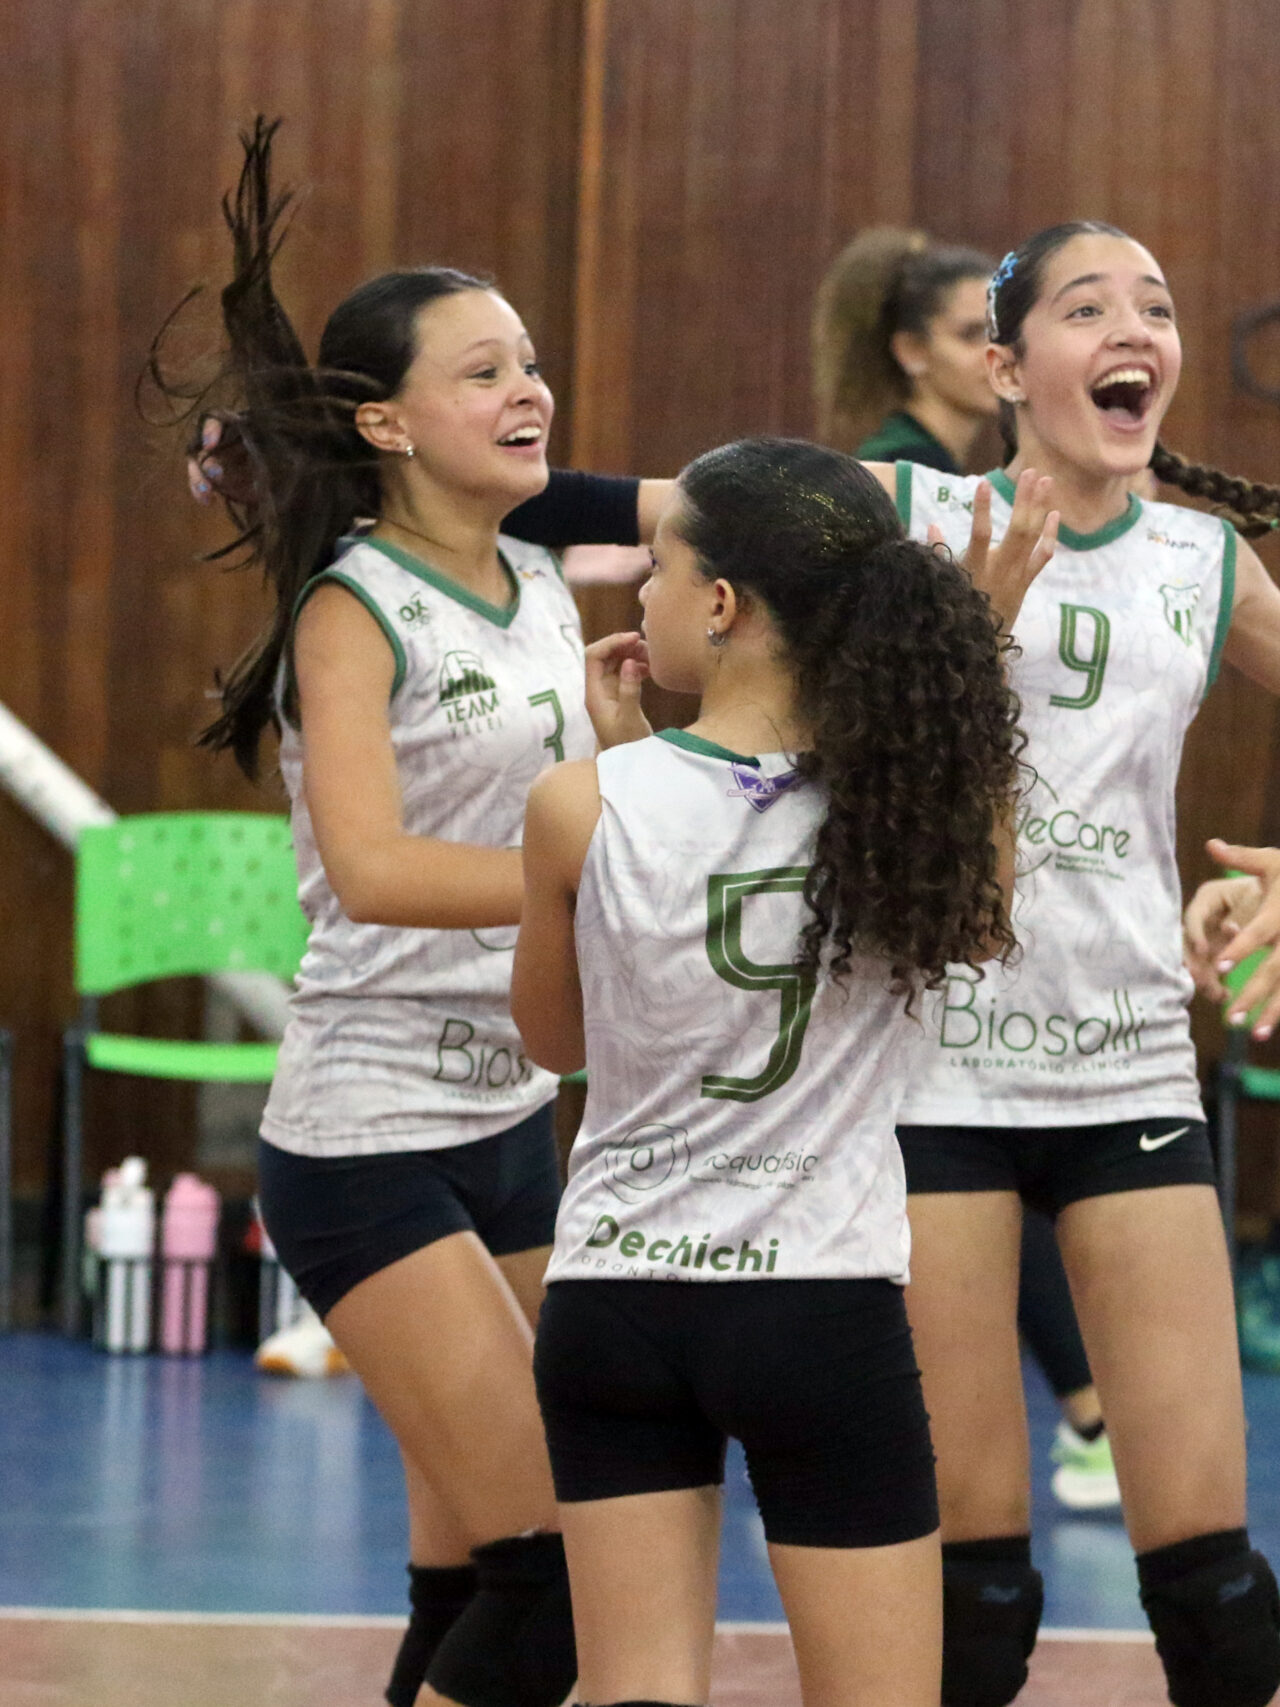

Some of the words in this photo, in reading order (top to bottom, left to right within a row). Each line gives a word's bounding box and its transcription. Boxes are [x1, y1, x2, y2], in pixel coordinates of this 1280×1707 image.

[1048, 602, 1111, 710] 9
[441, 691, 500, 723] TEAM
[940, 976, 1146, 1055] Biosalli
[432, 1018, 533, 1088] Bios
[586, 1215, 779, 1273] Dechichi
